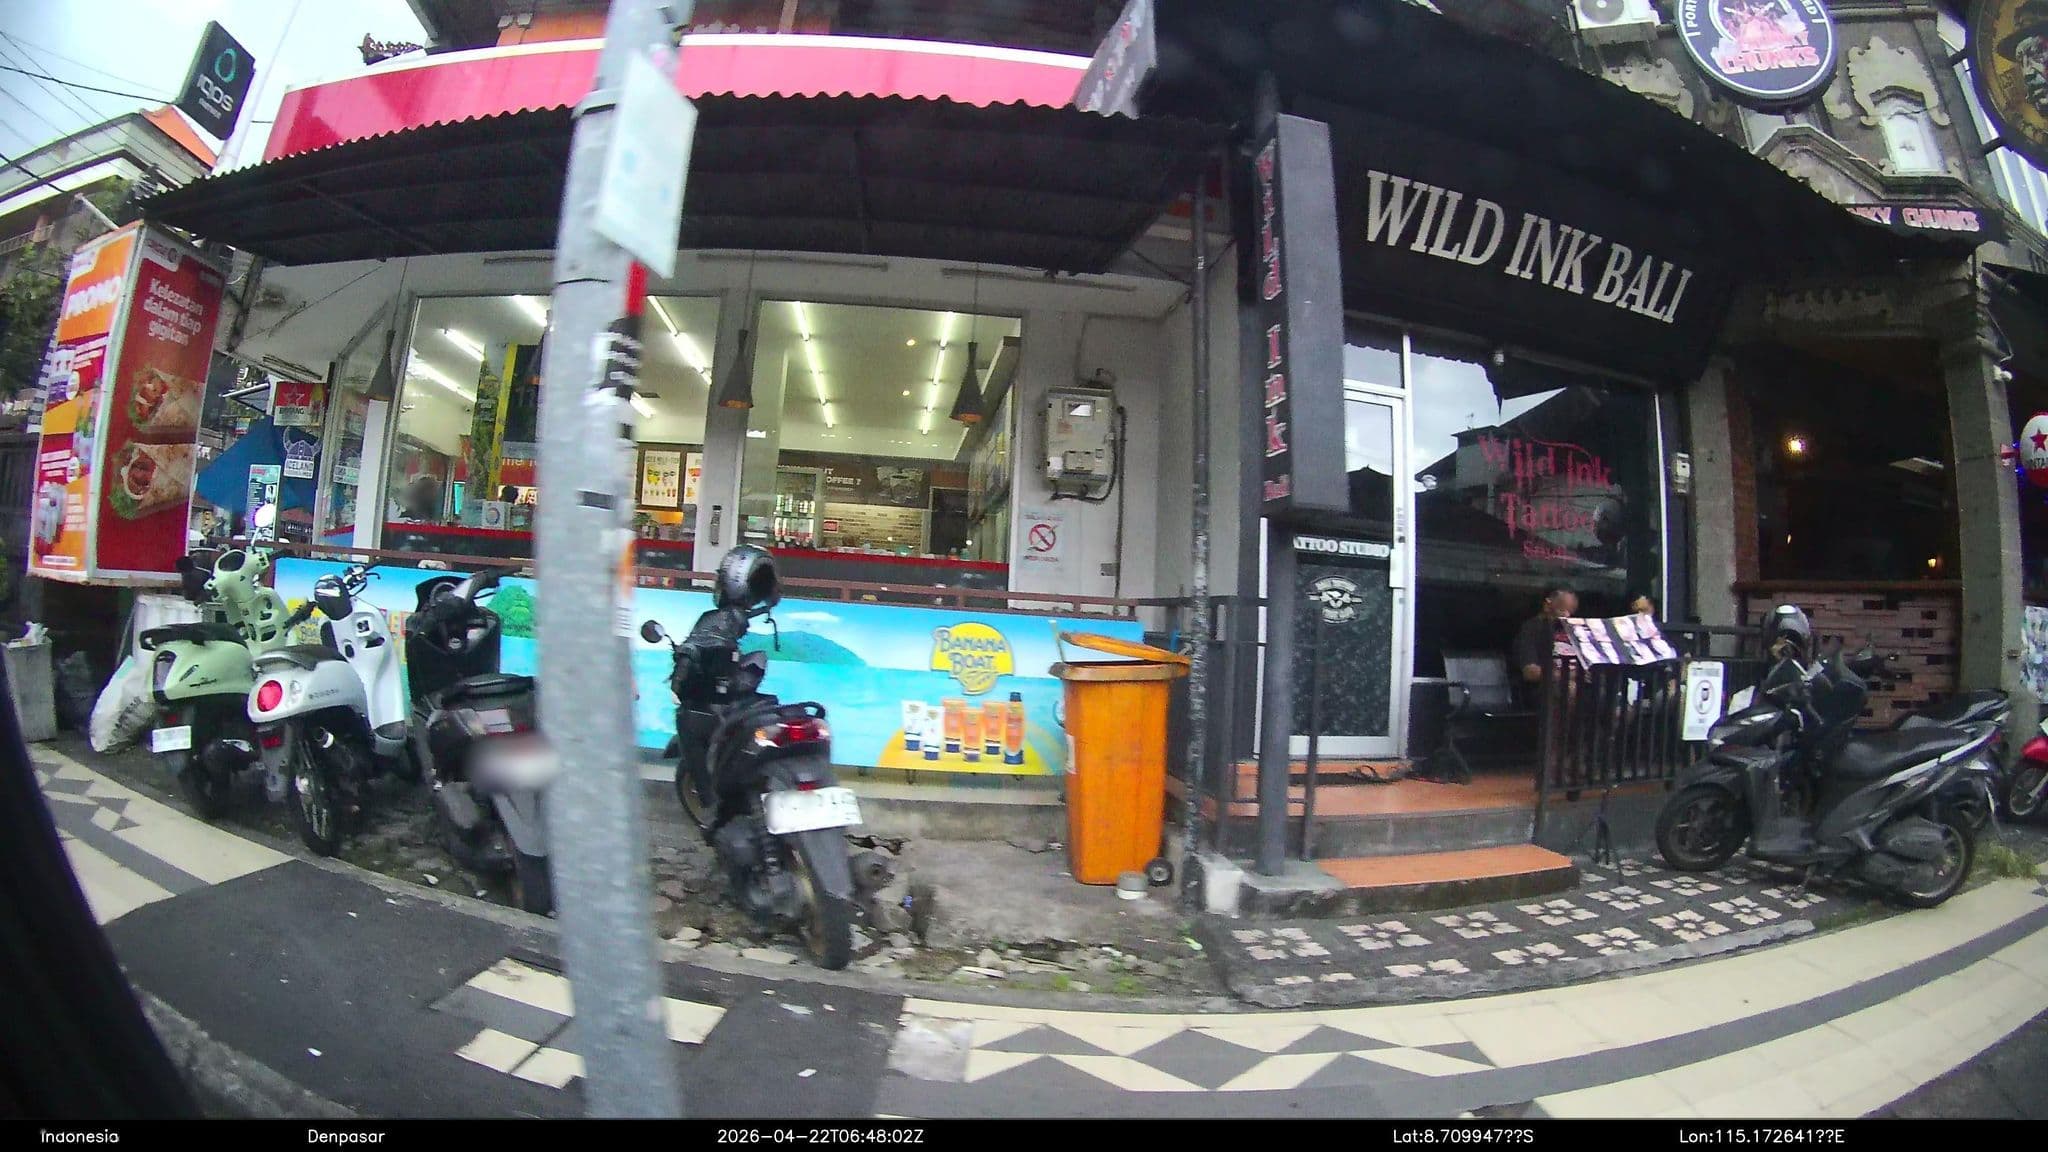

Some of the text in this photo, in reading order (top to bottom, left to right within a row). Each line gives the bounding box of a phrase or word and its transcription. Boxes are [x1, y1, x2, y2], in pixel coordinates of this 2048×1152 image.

[1685, 0, 1698, 28] POR
[1367, 170, 1693, 323] WILD INK BALI
[143, 296, 179, 323] dalam
[150, 277, 204, 316] Kelezatan
[148, 318, 189, 347] gigitan
[1338, 540, 1389, 558] STUDIO
[932, 626, 1006, 652] BANANA
[949, 652, 996, 676] BOAT
